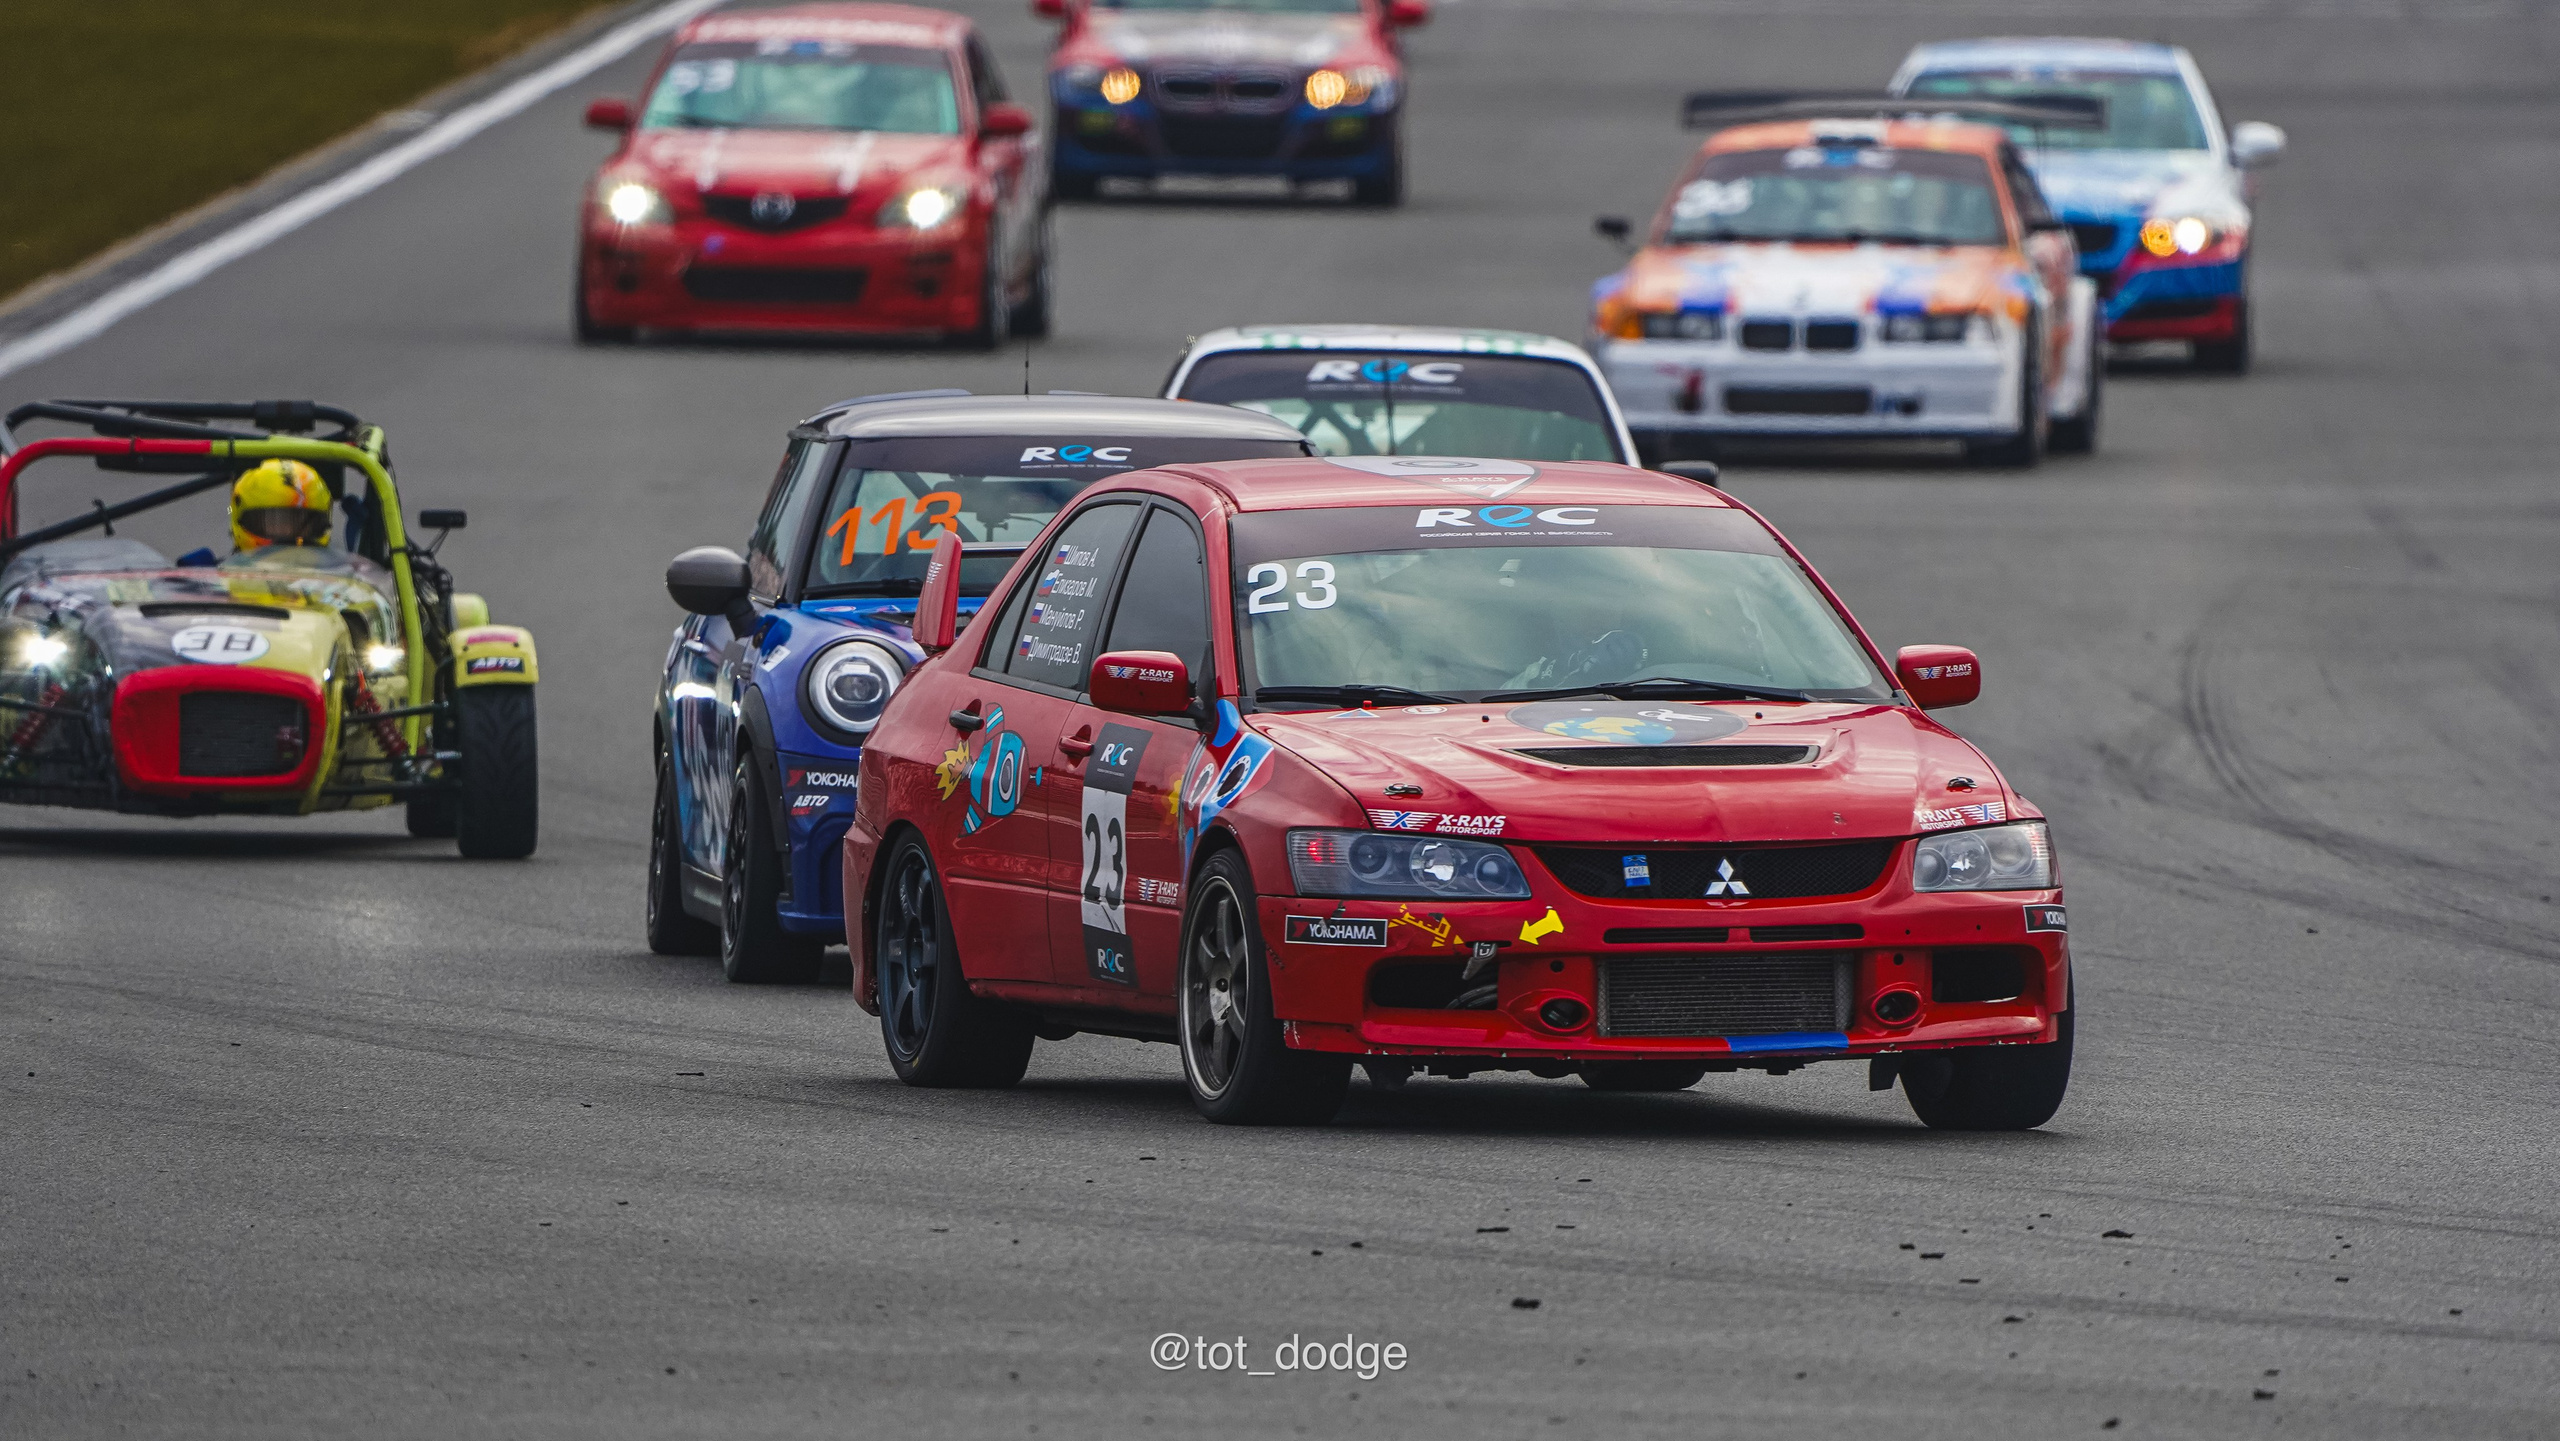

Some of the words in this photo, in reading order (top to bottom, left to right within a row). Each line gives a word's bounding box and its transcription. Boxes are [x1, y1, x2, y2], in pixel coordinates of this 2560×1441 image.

[826, 491, 962, 567] 113
[1063, 545, 1092, 567] Шипов
[1051, 572, 1088, 600] Елизаров
[1247, 560, 1337, 615] 23
[1039, 603, 1076, 632] Мануйлов
[180, 631, 257, 652] 38
[1139, 668, 1175, 679] X-RAYS
[1945, 663, 1973, 674] X-RAYS
[806, 771, 858, 788] YOKOHA
[793, 795, 830, 807] АВТО
[1438, 813, 1507, 828] X-RAYS
[1913, 808, 1963, 823] X-RAYS
[1436, 825, 1504, 836] MOTORSPORT
[1920, 818, 1967, 831] MOTORSPORT
[1084, 813, 1124, 911] 23
[1157, 881, 1179, 897] X-RAYS
